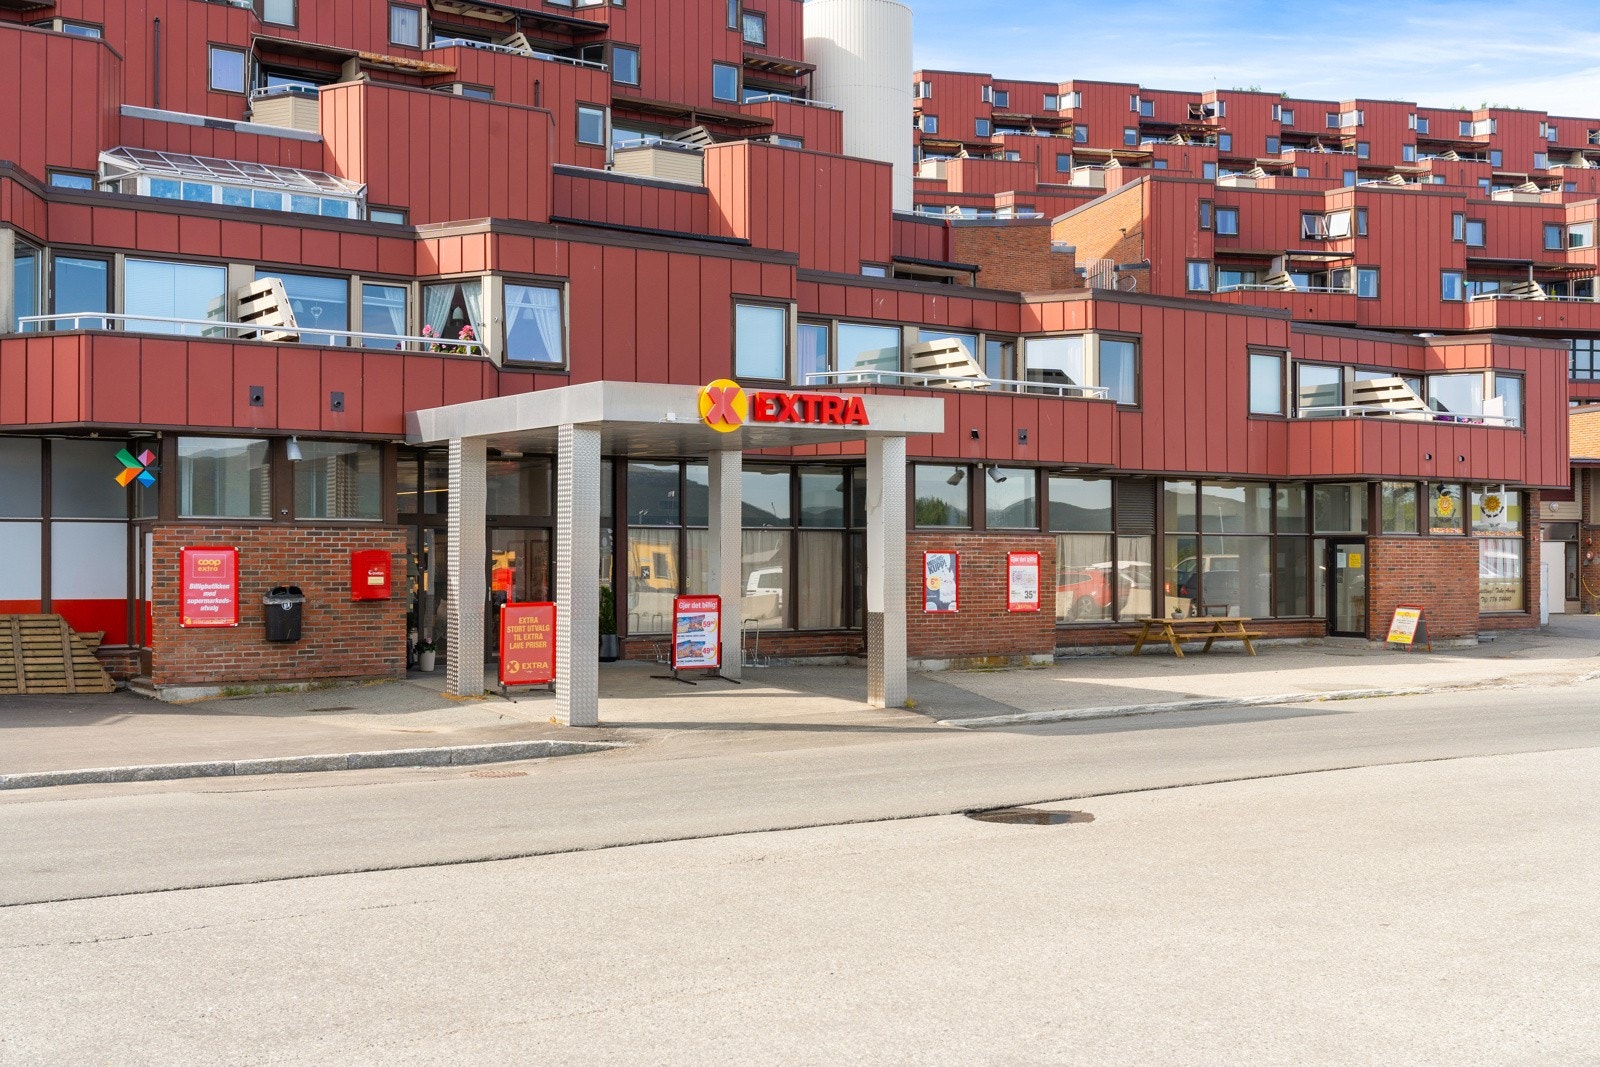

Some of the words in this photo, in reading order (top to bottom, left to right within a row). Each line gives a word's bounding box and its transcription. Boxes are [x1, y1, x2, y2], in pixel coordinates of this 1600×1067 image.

[754, 392, 870, 426] EXTRA
[198, 559, 221, 567] coop
[928, 559, 948, 575] KUPP!
[189, 583, 230, 591] Billigbutikken
[187, 597, 232, 605] supermarkeds-
[701, 601, 718, 610] billig!
[518, 616, 539, 624] EXTRA
[507, 625, 526, 633] STORT
[527, 624, 550, 632] UTVALG
[522, 662, 549, 670] EXTRA
